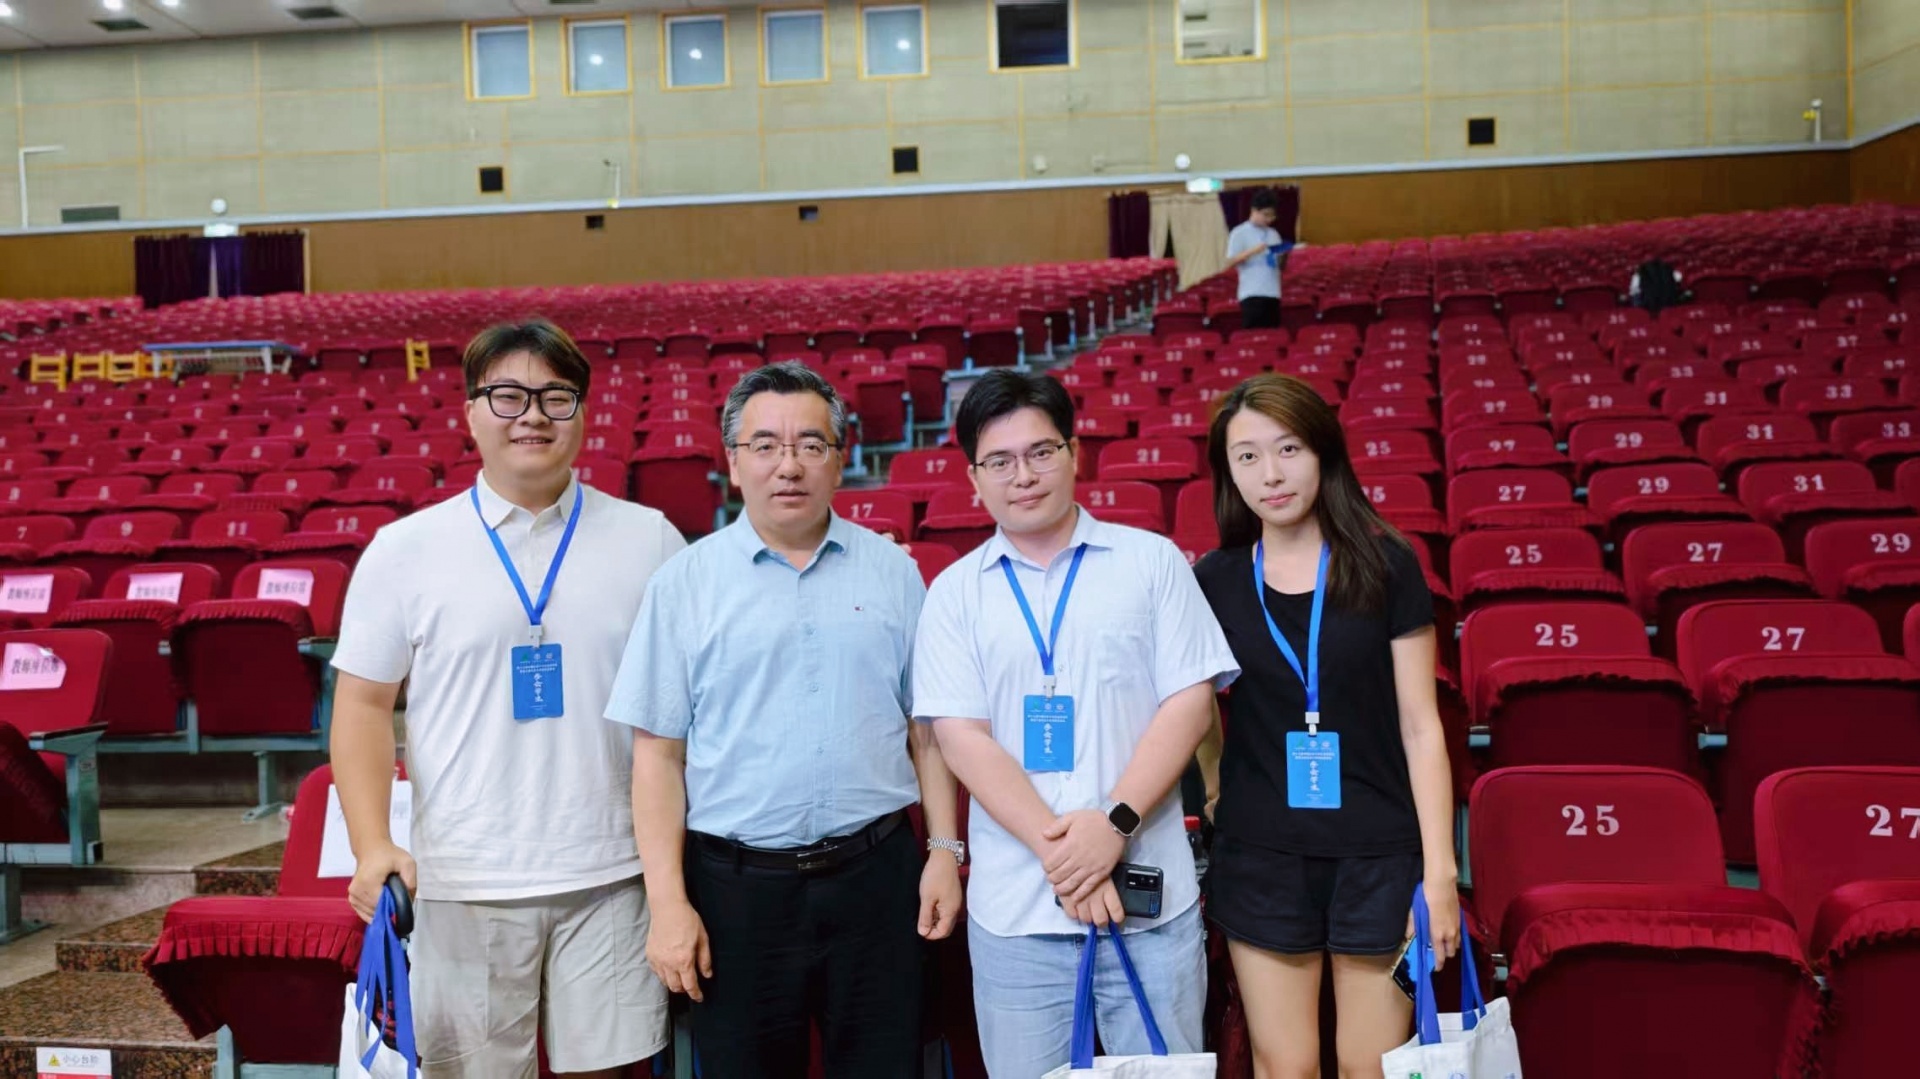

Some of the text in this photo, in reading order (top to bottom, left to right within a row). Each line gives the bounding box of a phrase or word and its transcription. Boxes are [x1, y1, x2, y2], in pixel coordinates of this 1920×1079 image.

[1705, 392, 1726, 405] 31
[1827, 385, 1851, 398] 33
[1747, 425, 1772, 439] 31
[1884, 422, 1910, 437] 33
[1615, 433, 1642, 448] 29
[1137, 448, 1159, 465] 21
[1366, 441, 1390, 457] 25
[926, 459, 947, 473] 17
[1638, 477, 1669, 494] 29
[1795, 475, 1824, 491] 31
[1090, 491, 1115, 506] 21
[1499, 486, 1526, 501] 27
[851, 503, 873, 518] 17
[18, 526, 27, 539] 7
[121, 522, 132, 536] 9
[228, 522, 246, 537] 11
[1871, 533, 1910, 553] 29
[1506, 545, 1542, 564] 25
[1688, 543, 1722, 561] 27
[1535, 624, 1578, 647] 25
[1762, 627, 1805, 650] 27
[1562, 805, 1619, 835] 25
[1866, 805, 1920, 838] 27
